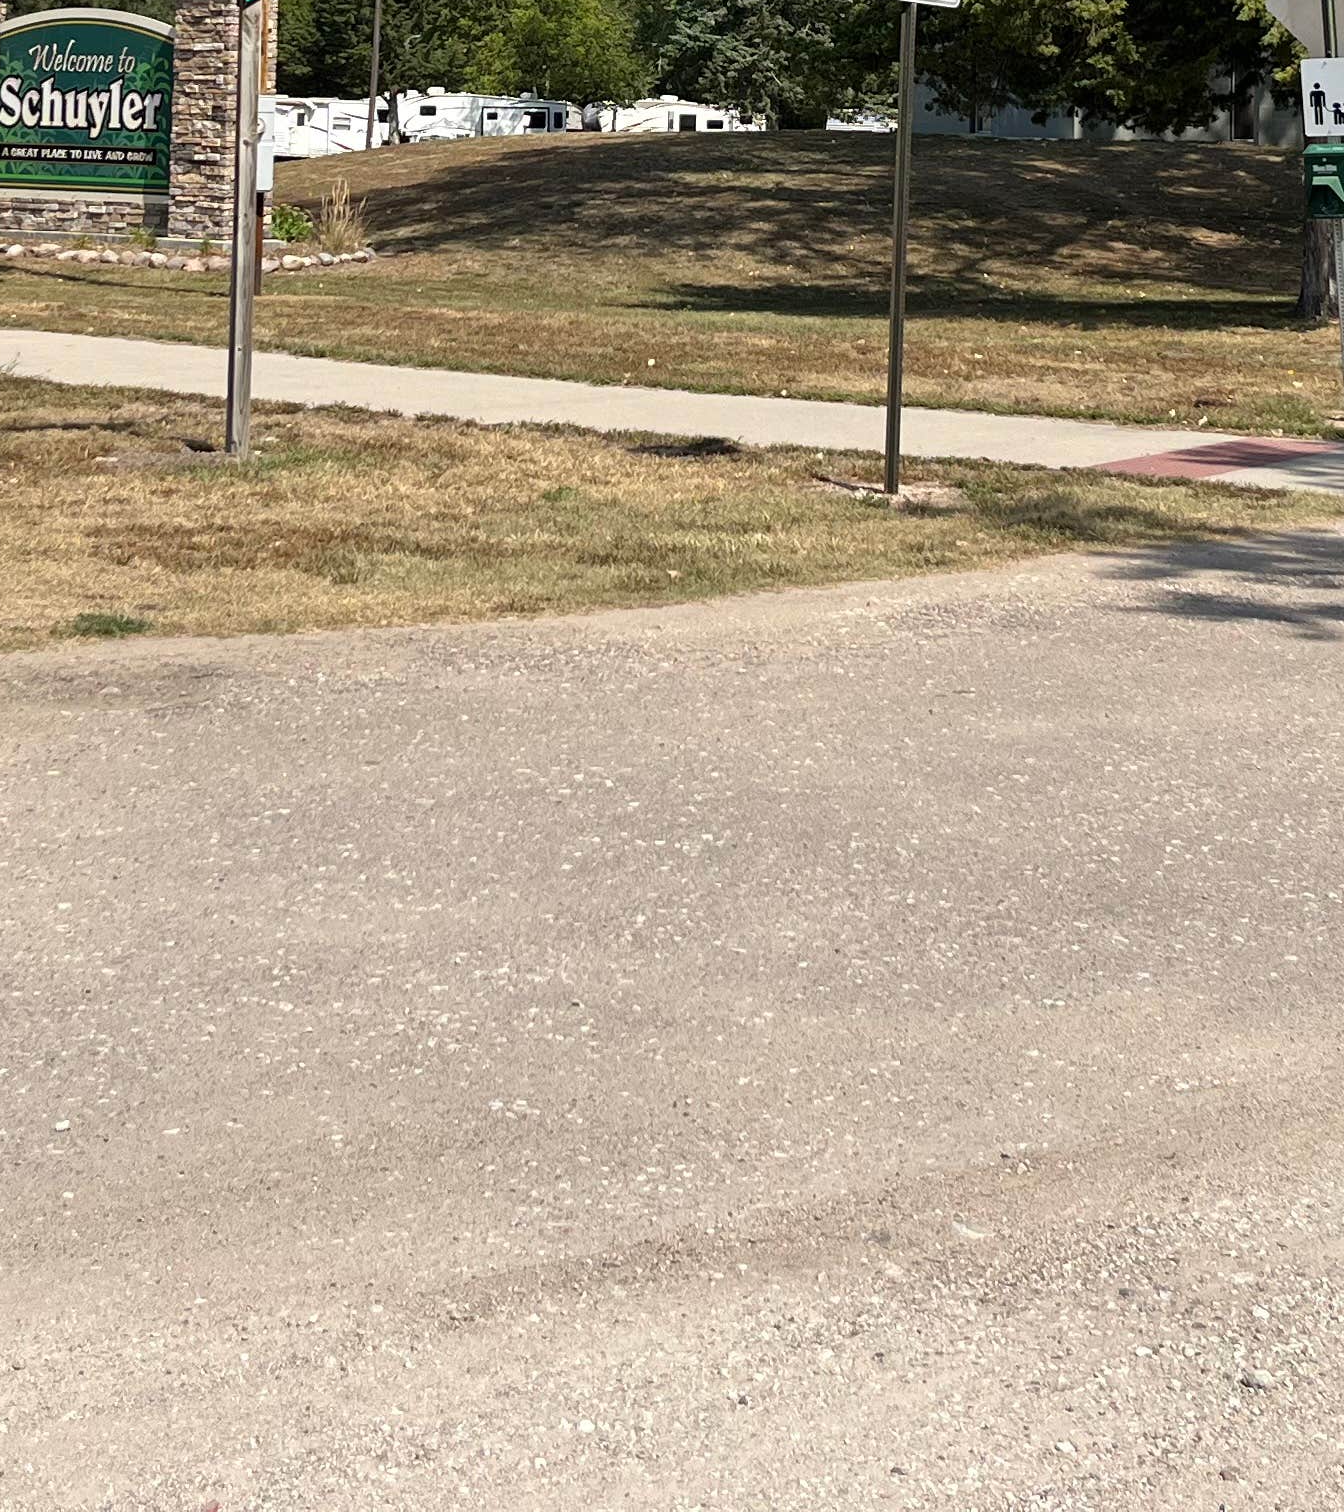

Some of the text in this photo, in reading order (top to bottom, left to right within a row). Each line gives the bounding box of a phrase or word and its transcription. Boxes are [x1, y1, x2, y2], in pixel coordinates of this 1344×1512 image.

[28, 39, 136, 73] Welcome to
[1, 147, 9, 157] A
[10, 148, 39, 158] GREAT
[41, 149, 68, 159] PLACE
[69, 149, 82, 159] TO
[83, 150, 104, 160] LIVE
[105, 151, 125, 161] AND
